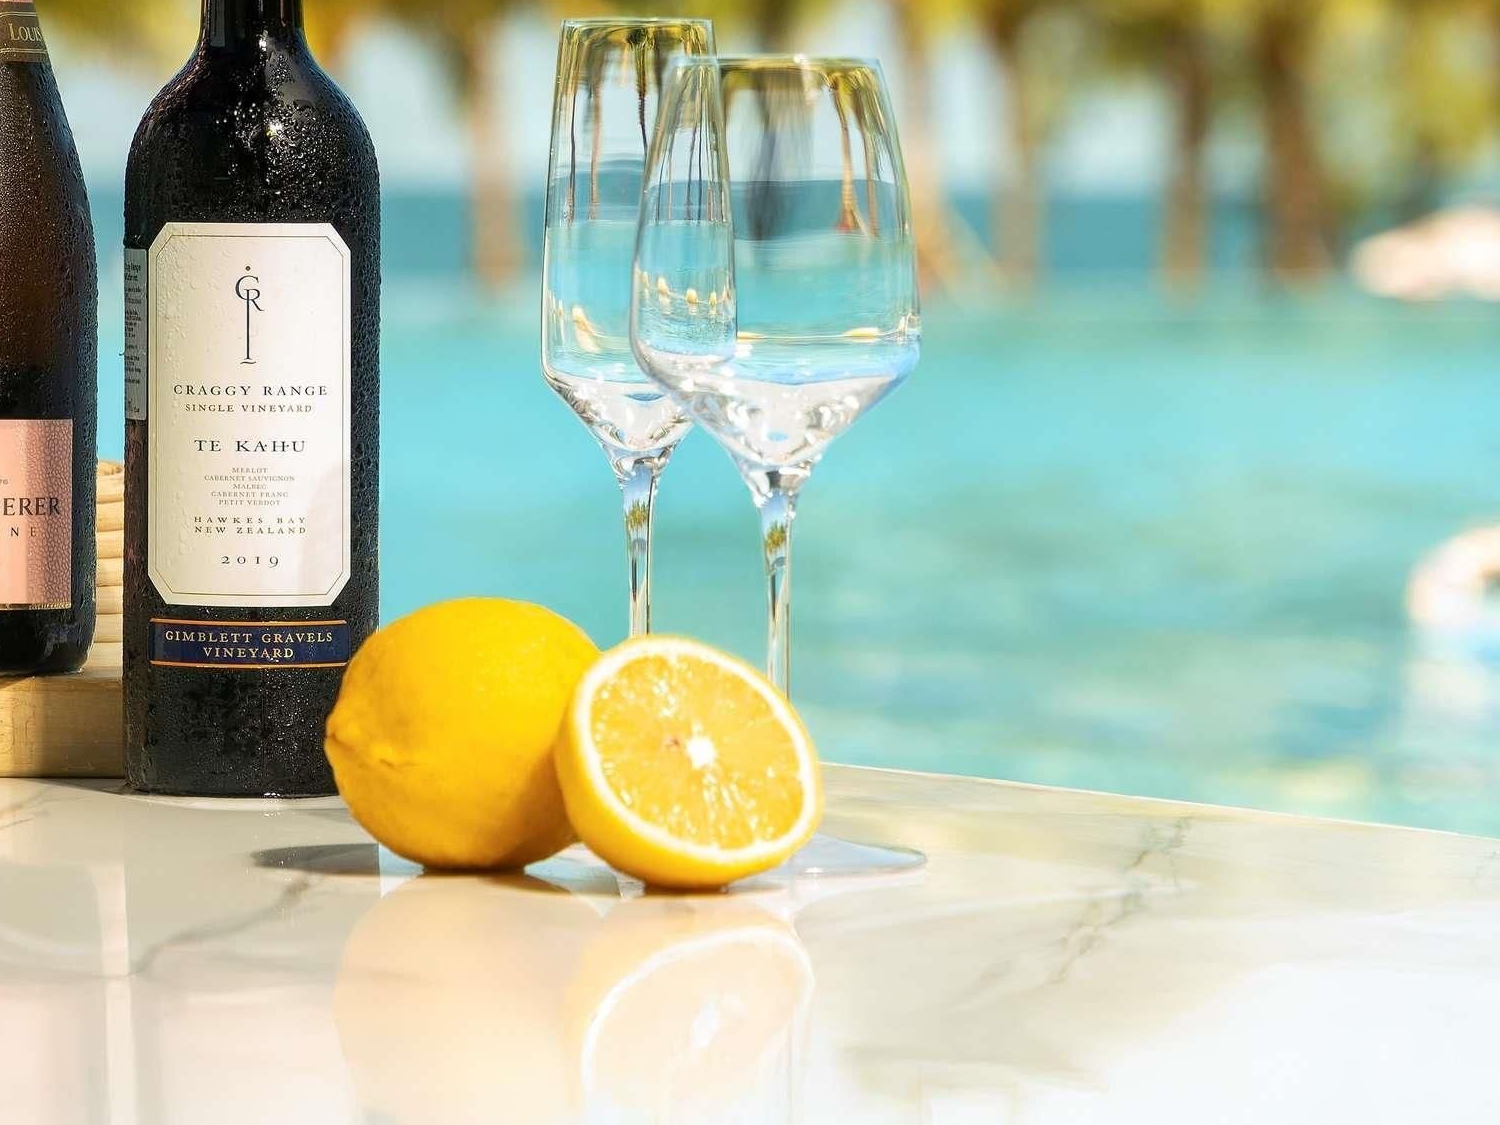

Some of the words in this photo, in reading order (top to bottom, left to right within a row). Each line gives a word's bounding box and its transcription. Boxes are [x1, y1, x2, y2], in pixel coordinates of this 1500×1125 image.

[173, 384, 251, 396] CRAGGY
[263, 385, 328, 396] RANGE
[185, 403, 235, 412] SINGLE
[241, 403, 313, 413] VINEYARD
[194, 439, 222, 452] TE
[193, 516, 264, 524] HAWKES
[276, 516, 307, 524] BAY
[194, 526, 227, 534] NEW
[236, 526, 307, 535] ZEALAND
[220, 555, 280, 568] 2019
[165, 631, 253, 643] GIMBLETT
[261, 632, 333, 643] GRAVELS
[202, 647, 295, 659] VINEYARD
